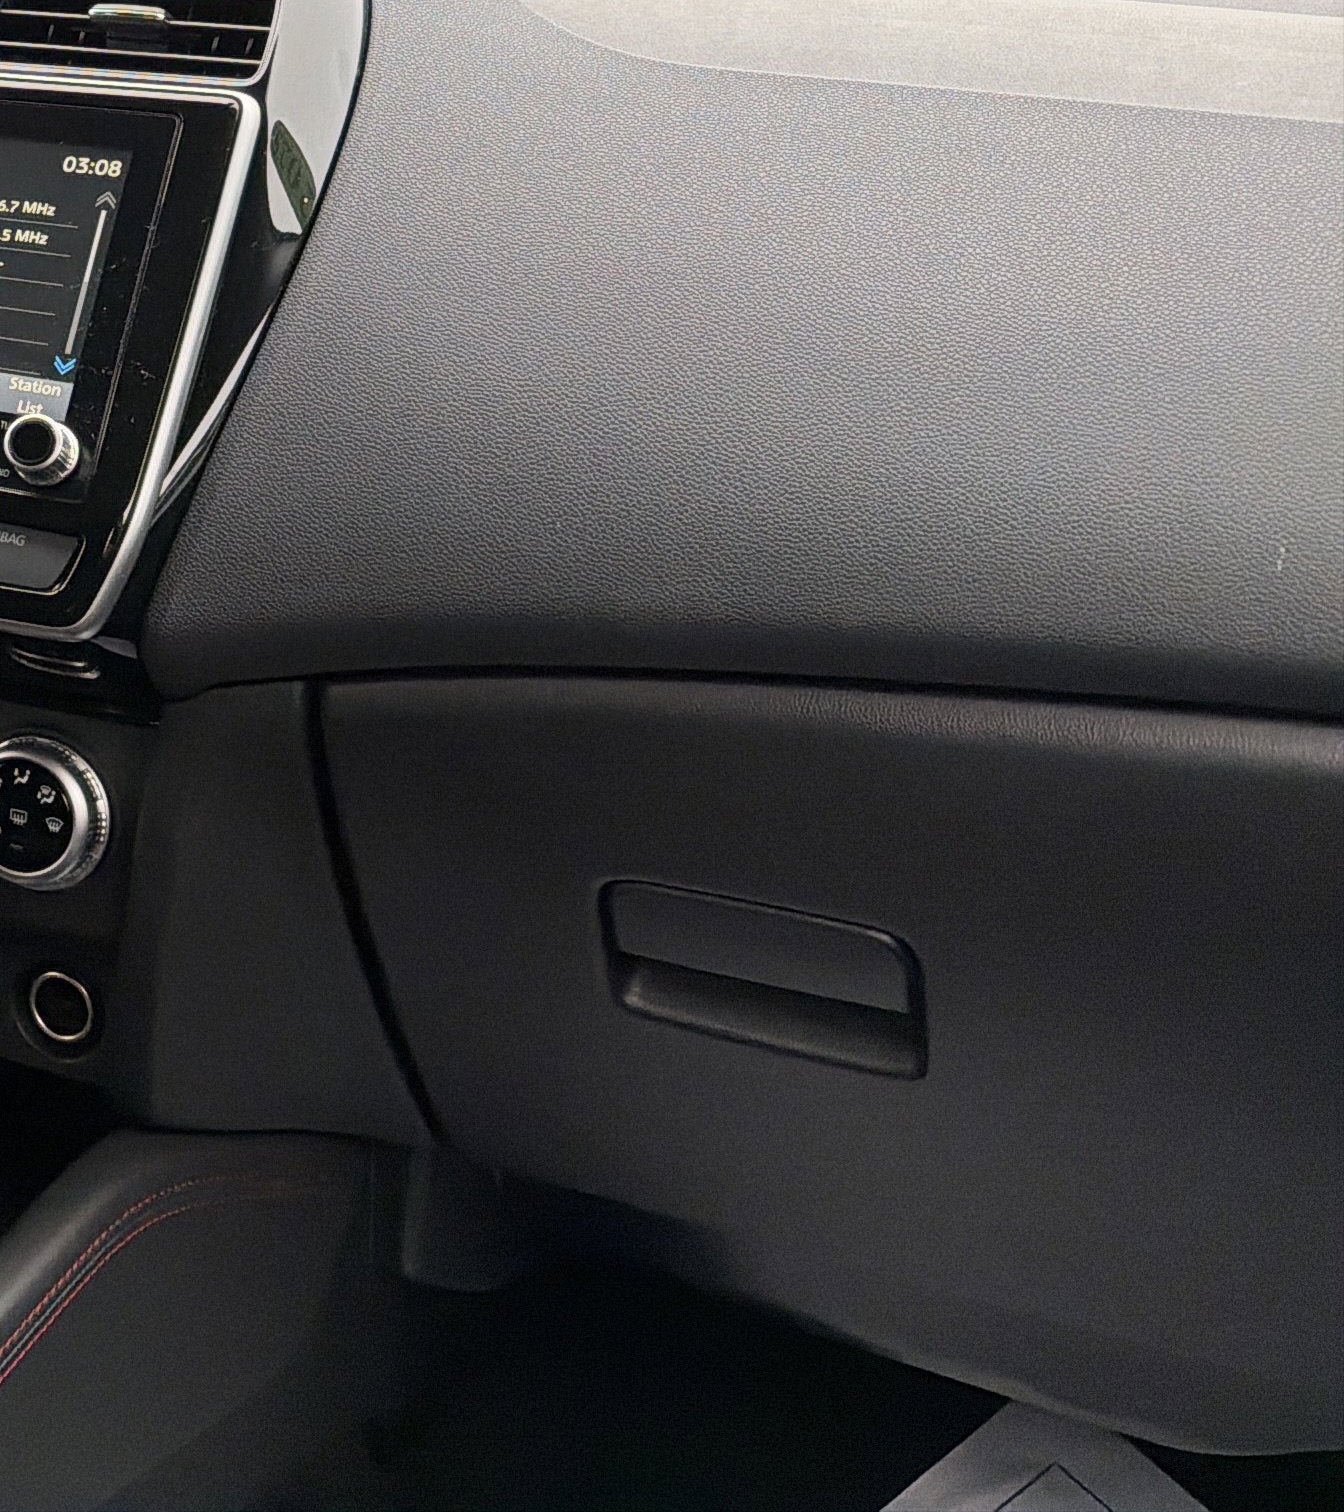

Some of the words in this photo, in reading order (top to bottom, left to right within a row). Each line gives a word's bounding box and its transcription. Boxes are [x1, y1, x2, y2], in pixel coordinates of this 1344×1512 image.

[62, 156, 123, 178] 03:08
[22, 201, 56, 217] MHz
[15, 229, 49, 246] MHz
[8, 376, 62, 397] Station
[16, 399, 44, 415] List
